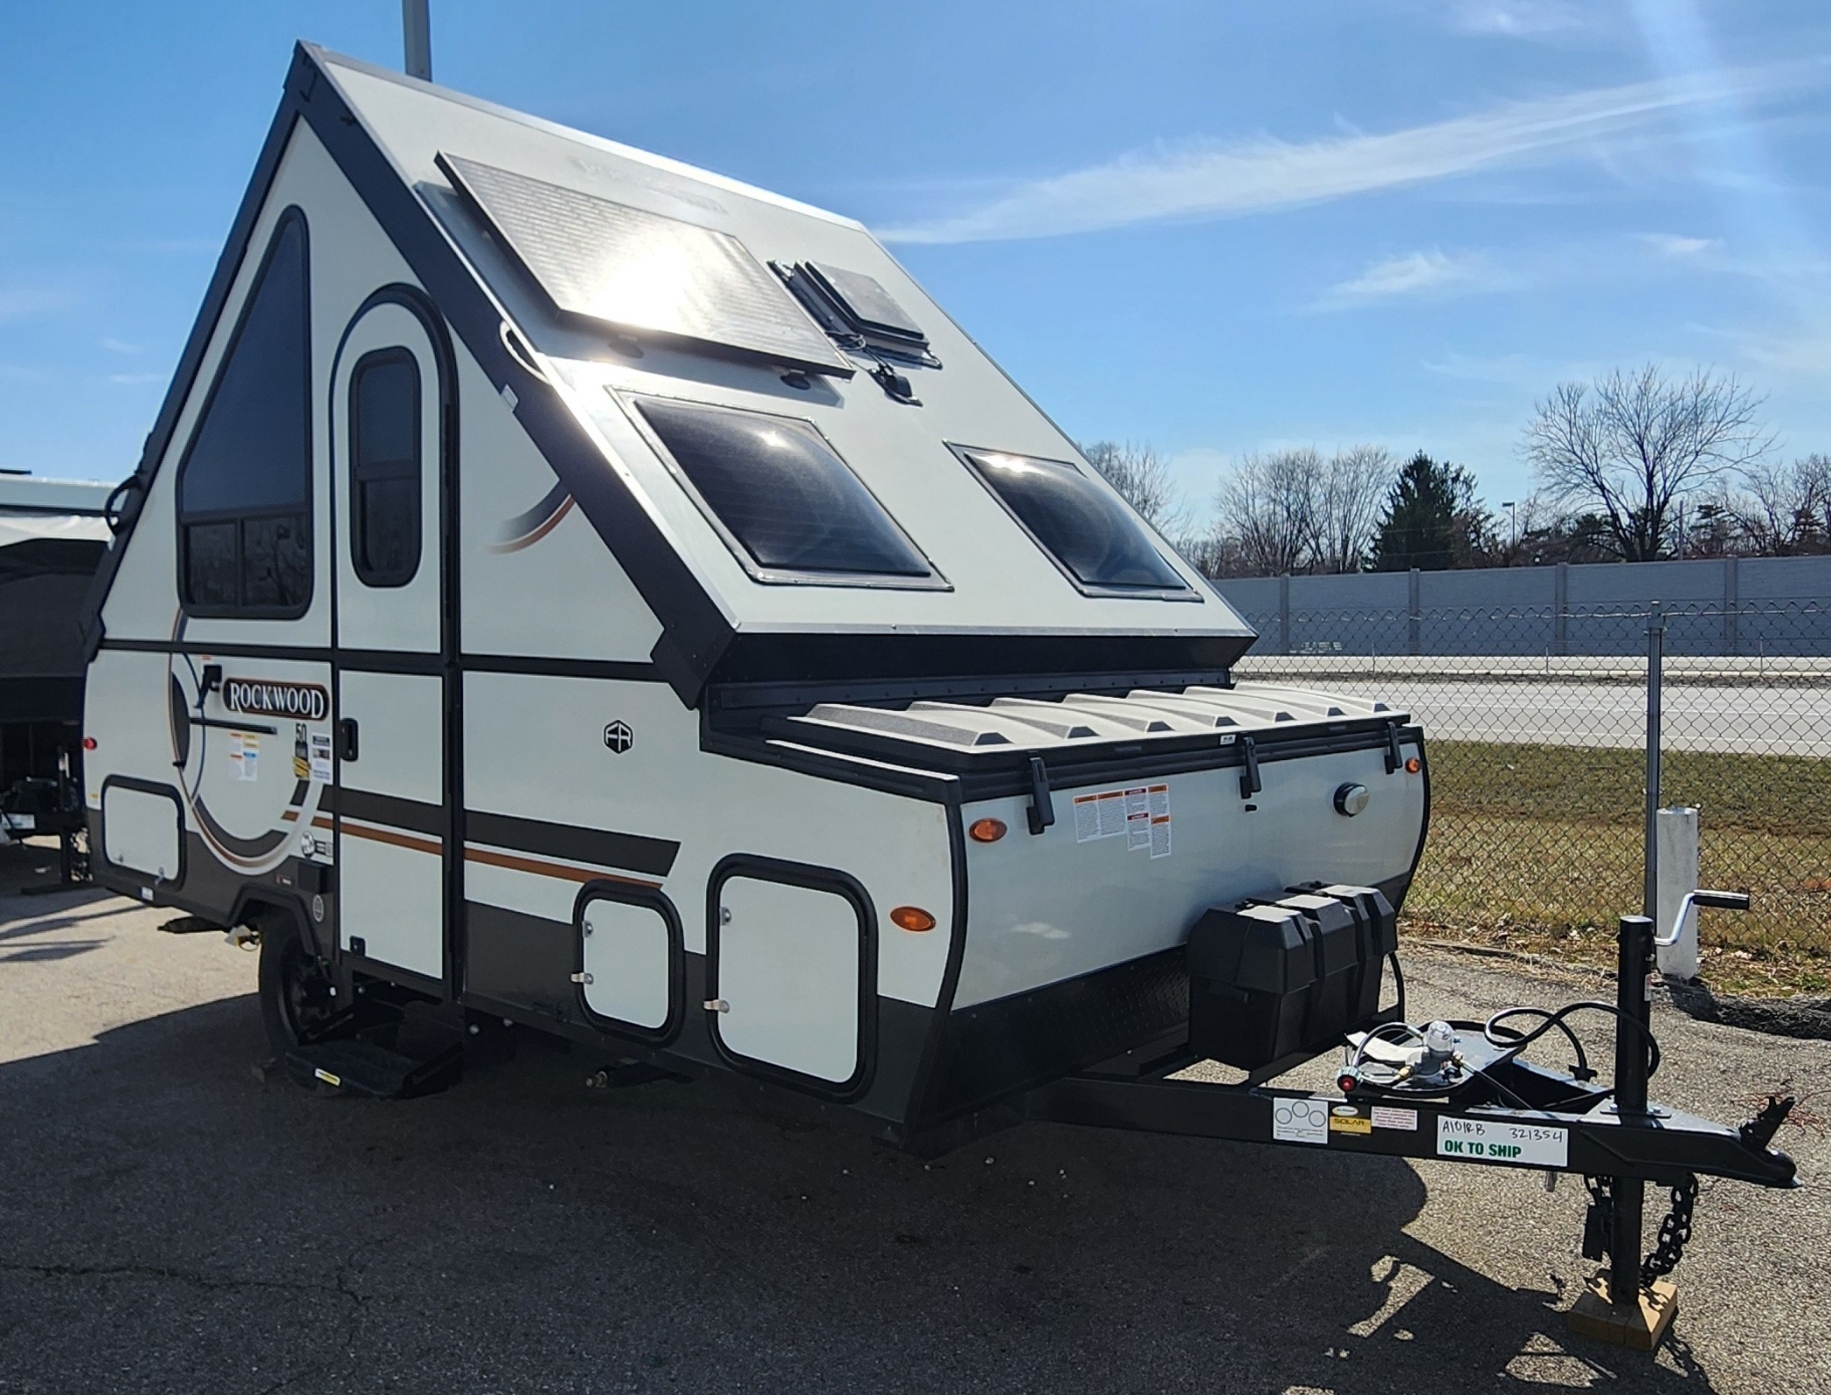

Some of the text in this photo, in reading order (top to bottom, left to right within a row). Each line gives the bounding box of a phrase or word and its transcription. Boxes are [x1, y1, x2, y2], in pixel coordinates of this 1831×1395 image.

[229, 682, 325, 719] ROCKWOOD
[1333, 1117, 1365, 1127] SOLAR
[1509, 1127, 1563, 1143] 321354
[1444, 1139, 1522, 1158] OK TO SHIP
